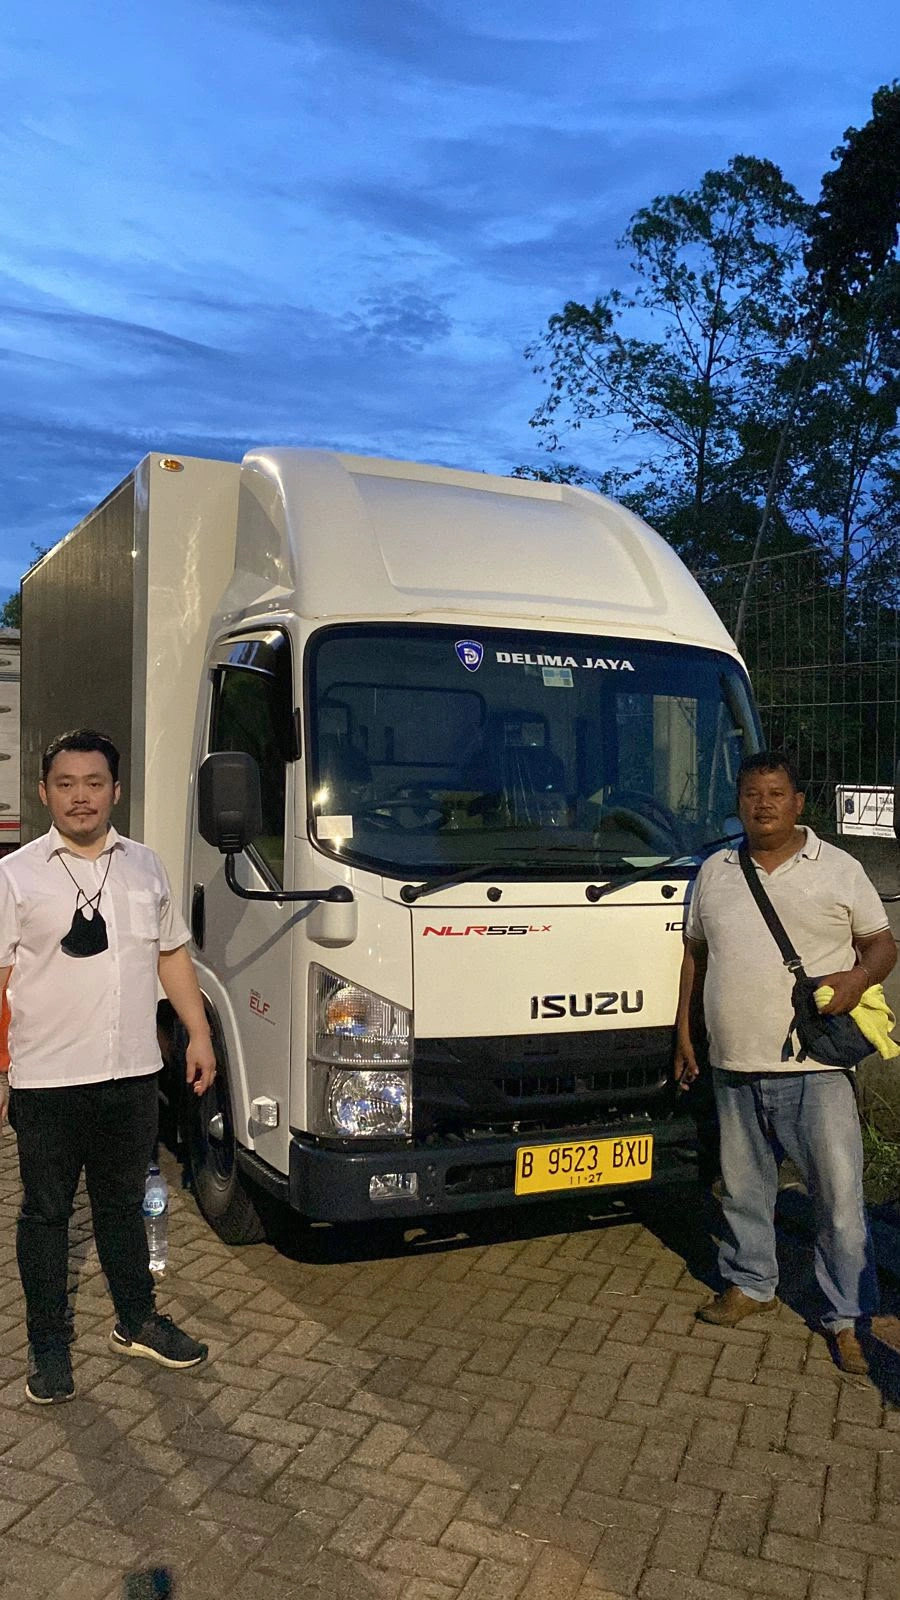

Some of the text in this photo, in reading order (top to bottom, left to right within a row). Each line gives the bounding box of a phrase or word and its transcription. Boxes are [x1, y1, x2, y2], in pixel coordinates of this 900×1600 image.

[496, 651, 635, 672] DELIMA JAYA
[250, 995, 270, 1015] ELF
[530, 989, 644, 1020] ISUZU
[521, 1139, 649, 1179] B 9523 BXU
